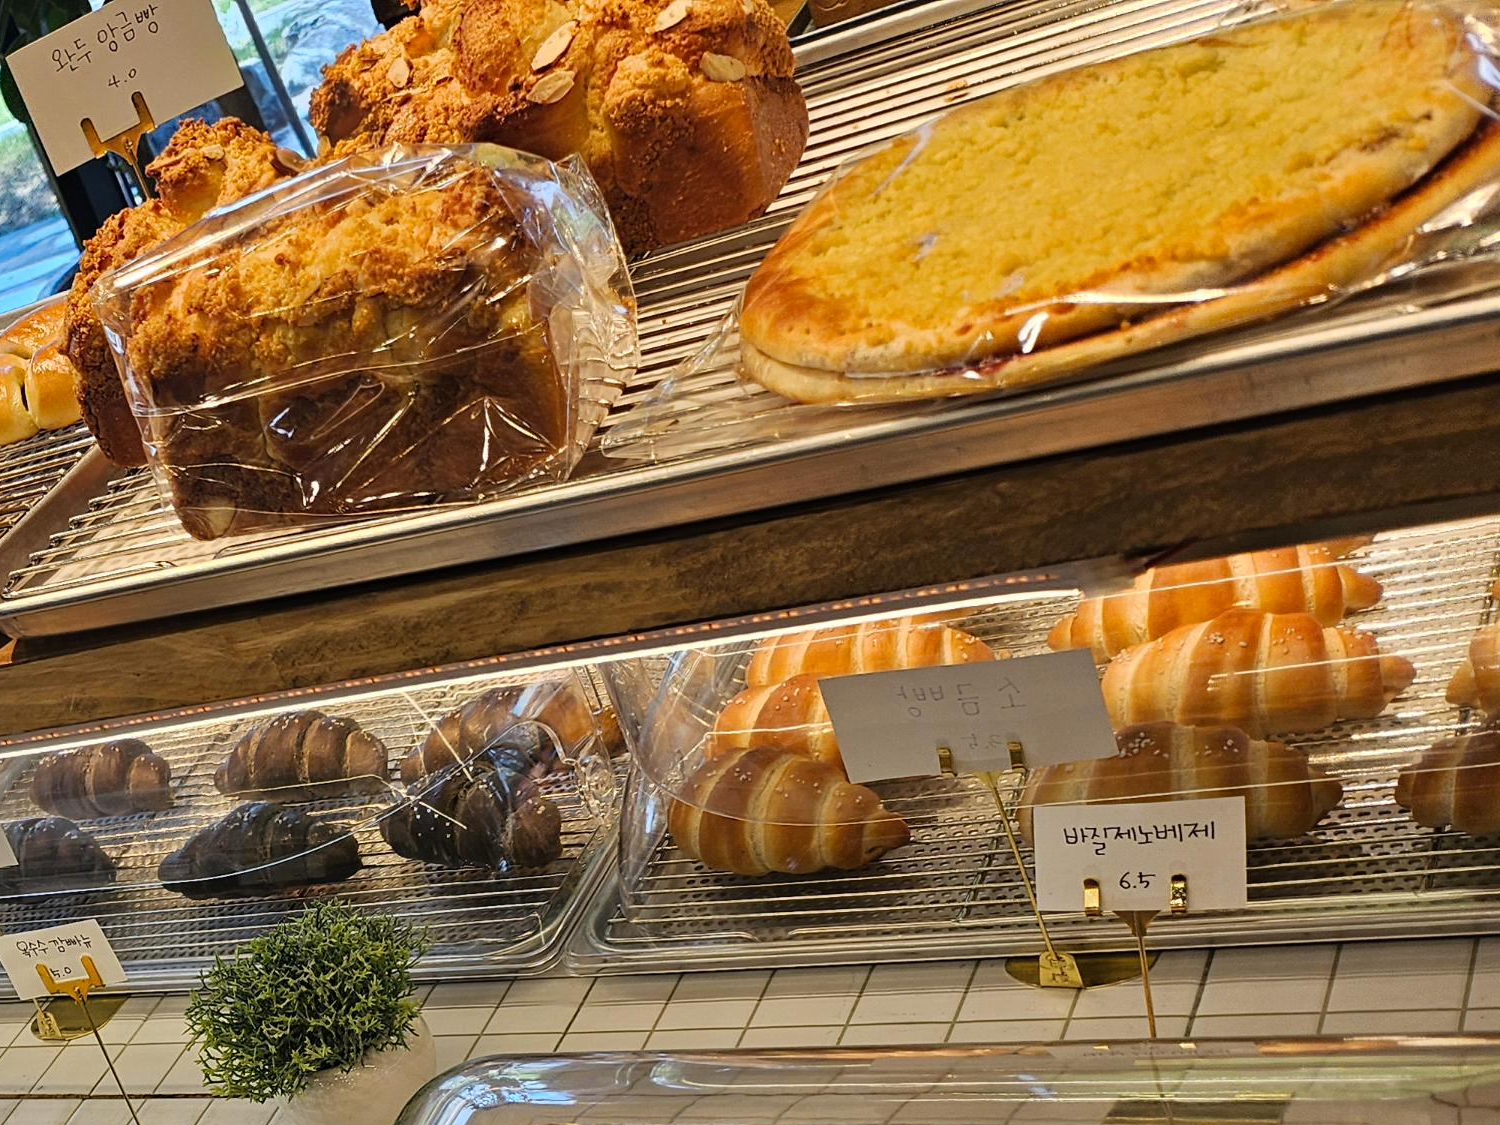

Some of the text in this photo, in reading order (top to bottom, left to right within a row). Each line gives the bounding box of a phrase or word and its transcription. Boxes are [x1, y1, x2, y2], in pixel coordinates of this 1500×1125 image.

[51, 4, 159, 72] 완두 앙금빵
[108, 68, 137, 88] 4.0
[1063, 821, 1215, 856] 바질제노베제
[1119, 871, 1156, 890] 6.5
[16, 934, 92, 958] 옥수수 깜빠뉴
[50, 966, 72, 978] 5.0
